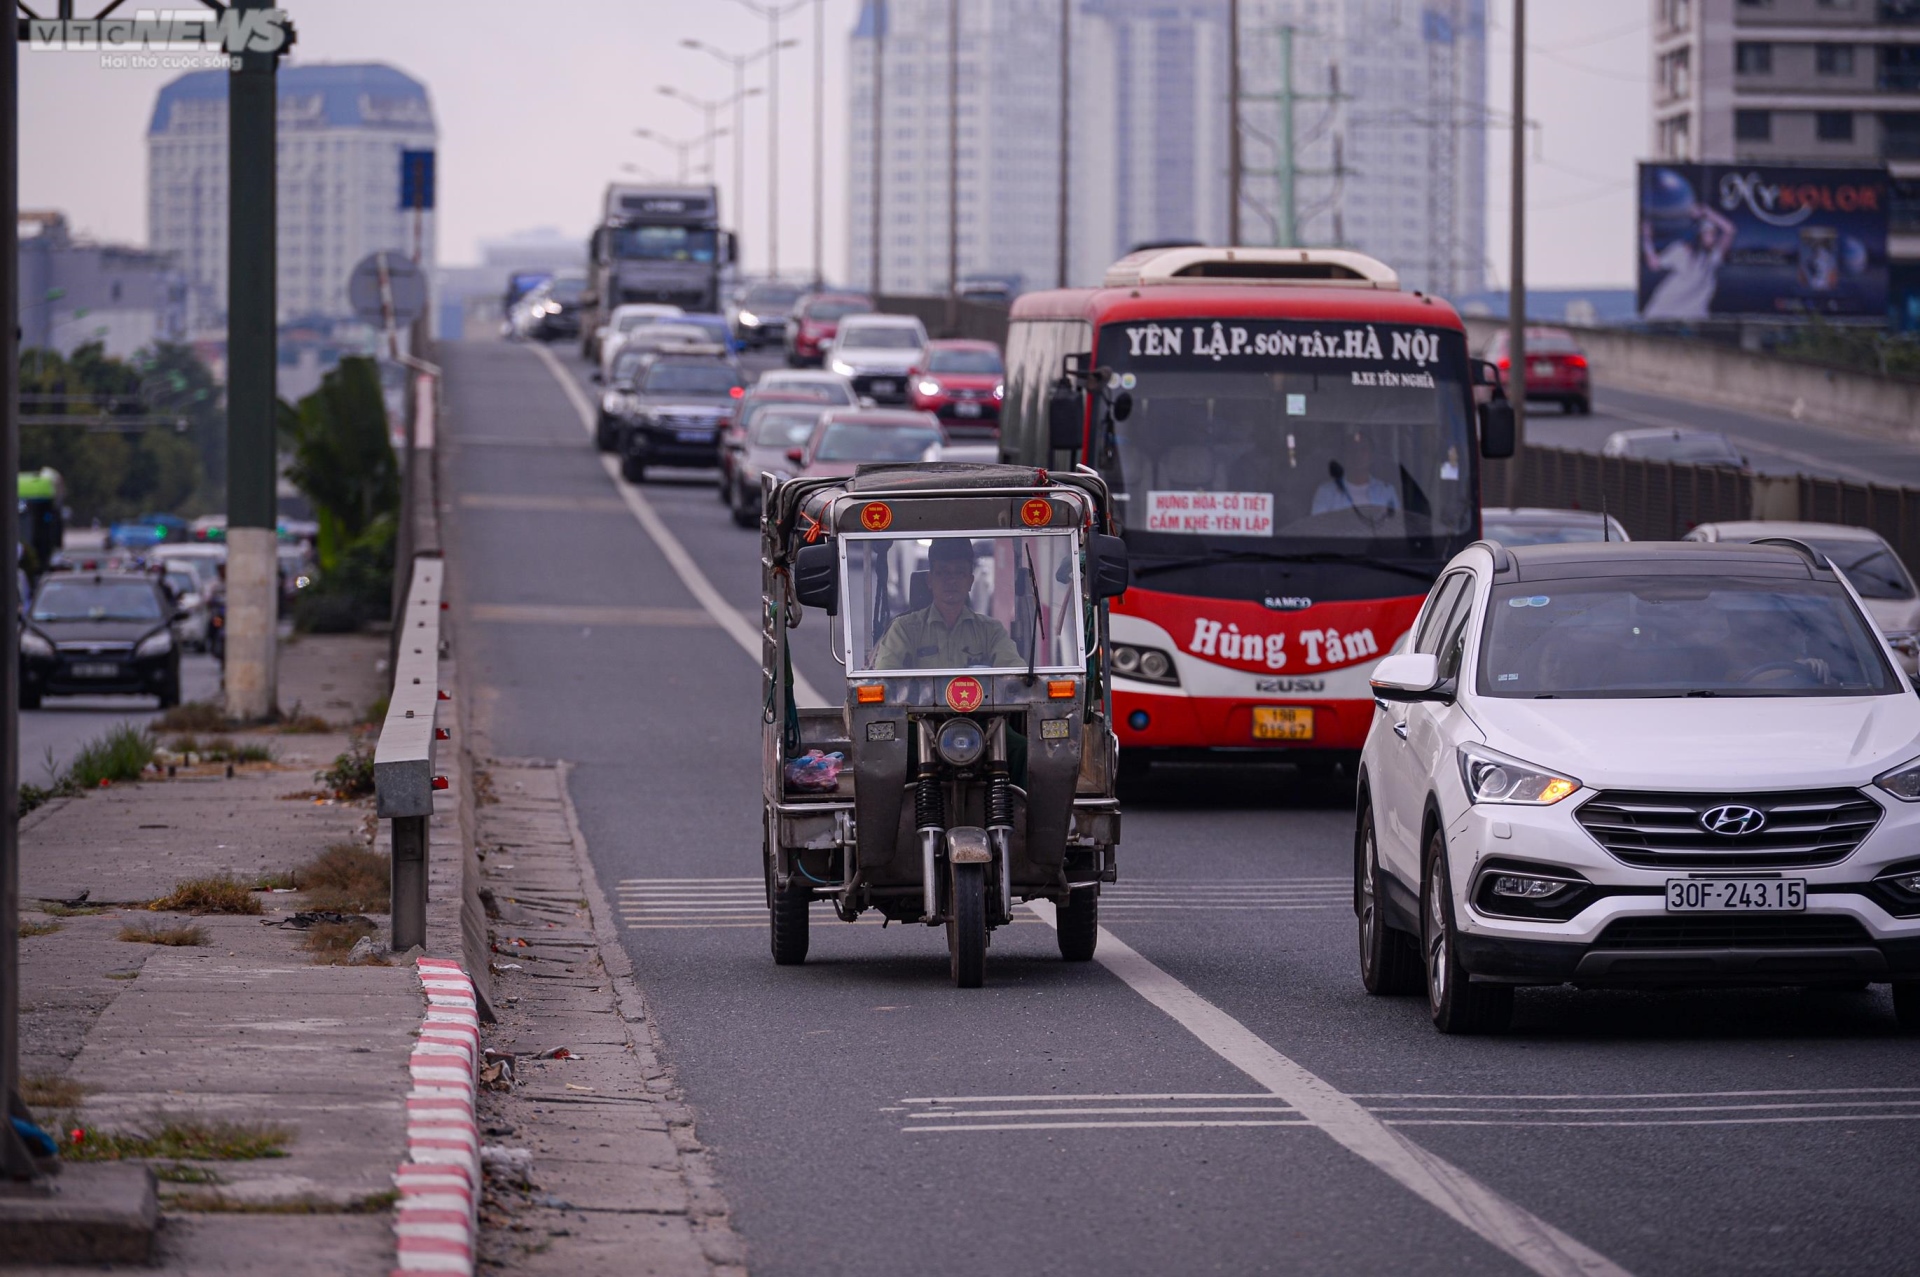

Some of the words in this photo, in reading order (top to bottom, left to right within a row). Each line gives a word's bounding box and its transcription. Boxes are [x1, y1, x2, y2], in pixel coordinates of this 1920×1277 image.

[1126, 323, 1183, 355] YÊN
[1391, 329, 1440, 366] NỘI
[1378, 370, 1400, 387] YÊN
[1264, 597, 1312, 609] SAMCO
[1189, 617, 1287, 669] Hùng
[1299, 627, 1379, 666] Tâm
[1670, 882, 1801, 908] 30F-243.15
